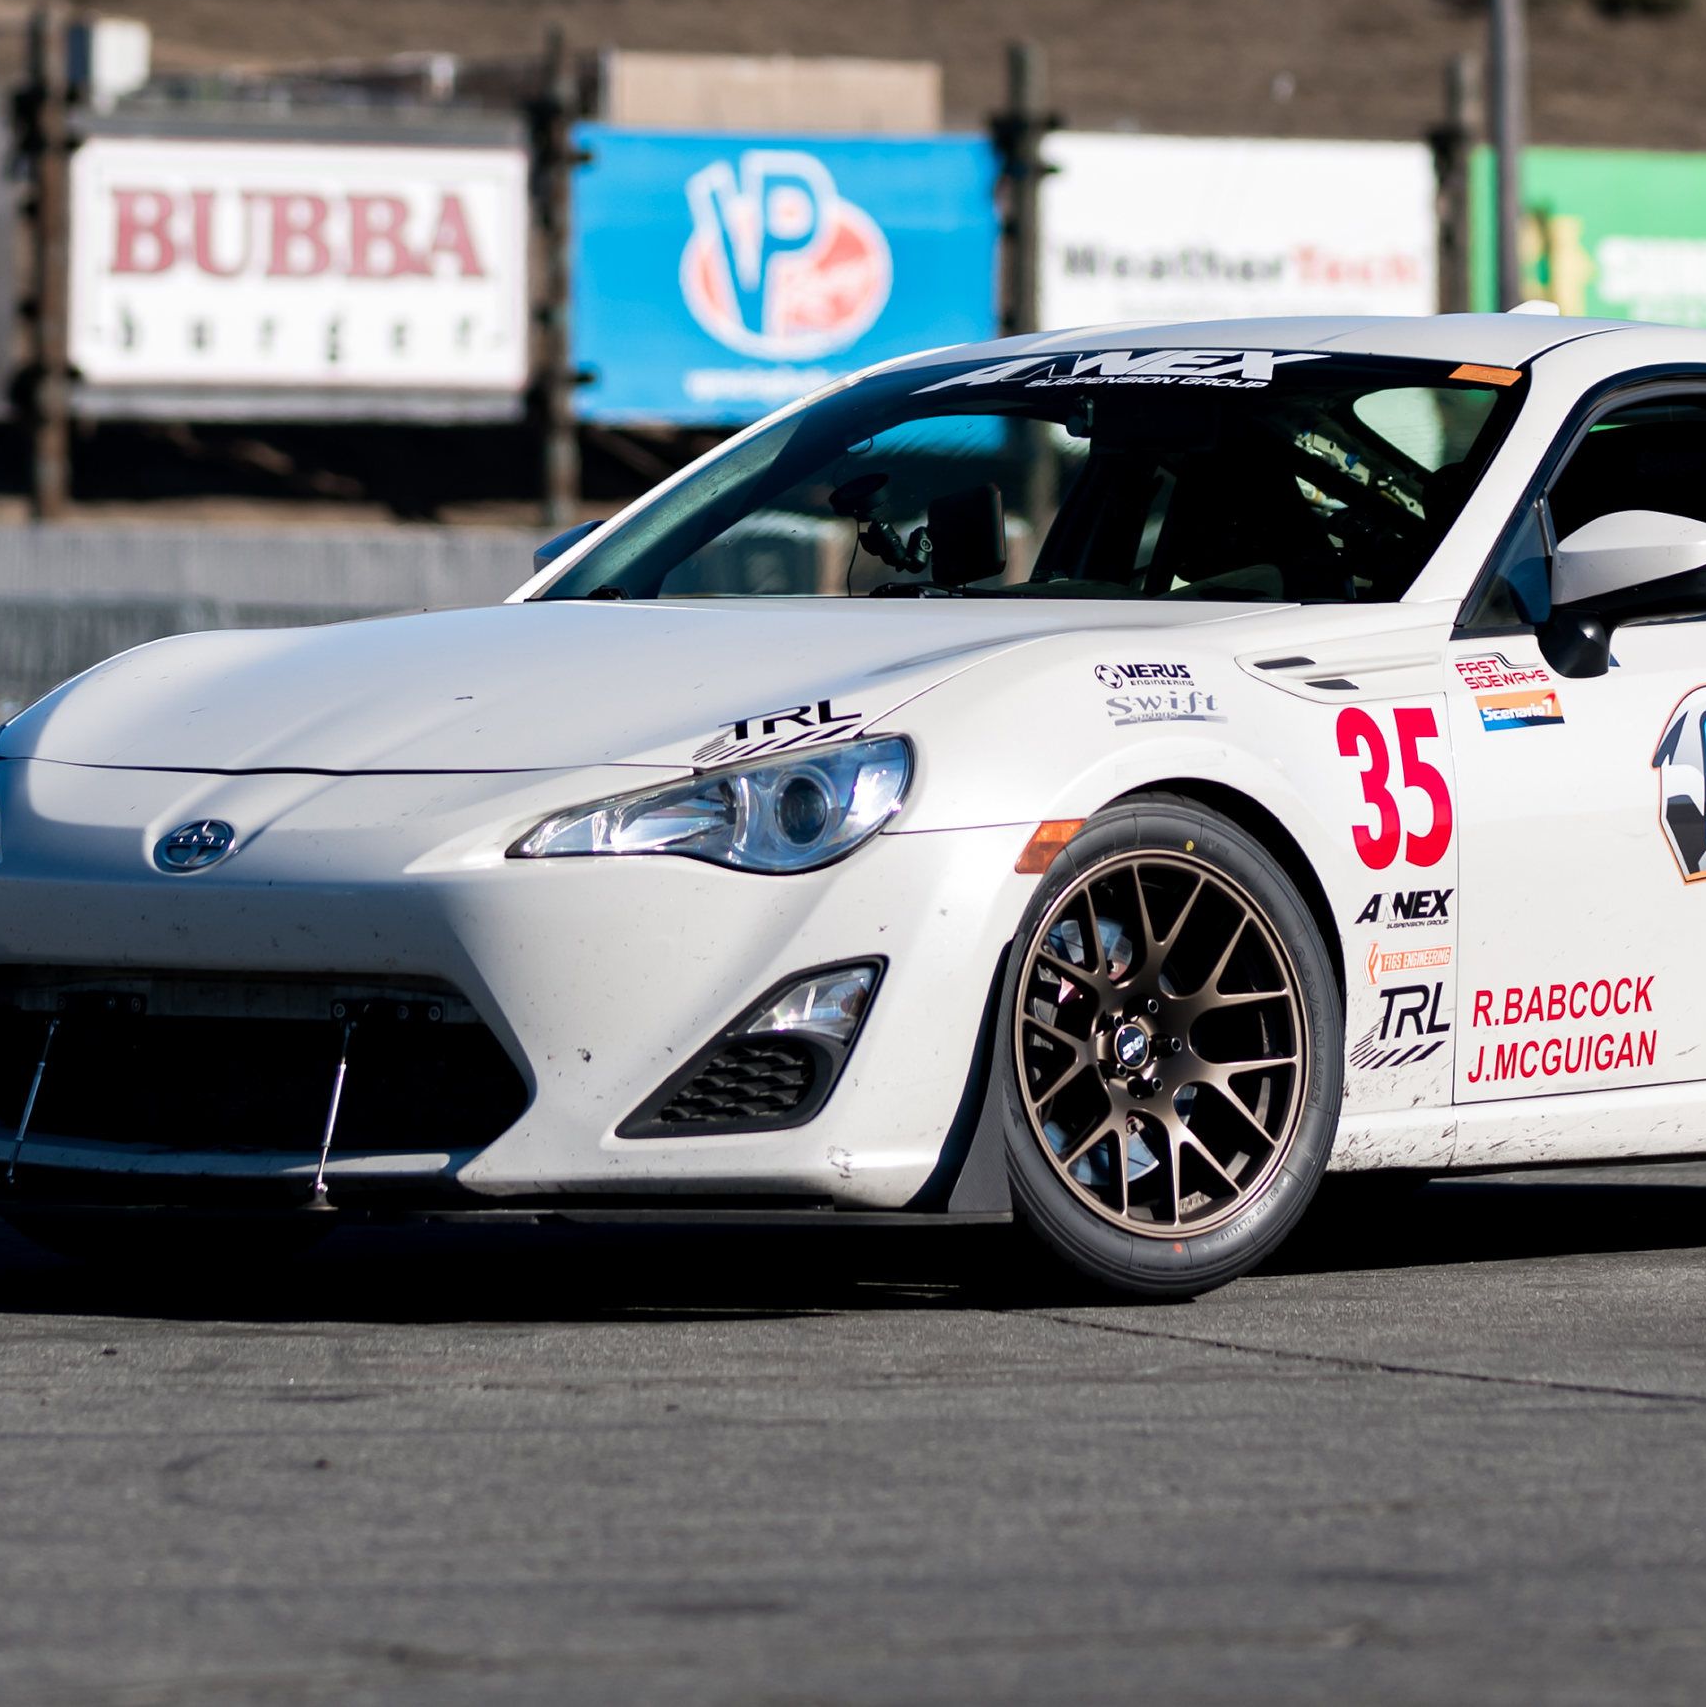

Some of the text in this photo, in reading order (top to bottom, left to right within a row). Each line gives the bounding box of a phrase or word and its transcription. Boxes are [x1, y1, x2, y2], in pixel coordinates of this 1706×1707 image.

[109, 186, 483, 279] BUBBA
[686, 149, 839, 341] VP
[1025, 374, 1270, 390] SUSPENSION GROUP
[1116, 664, 1191, 679] VERUS
[1455, 659, 1499, 675] FAST
[1465, 670, 1549, 689] SIDEWAYS
[718, 699, 862, 741] TRL
[1336, 707, 1453, 870] 35
[1354, 888, 1454, 925] ANNEX
[1384, 948, 1451, 971] FIGS ENGINEERING
[1379, 981, 1451, 1041] TRL
[1473, 975, 1655, 1028] R.BABCOCK
[1468, 1030, 1657, 1083] J.MCGUIGAN
